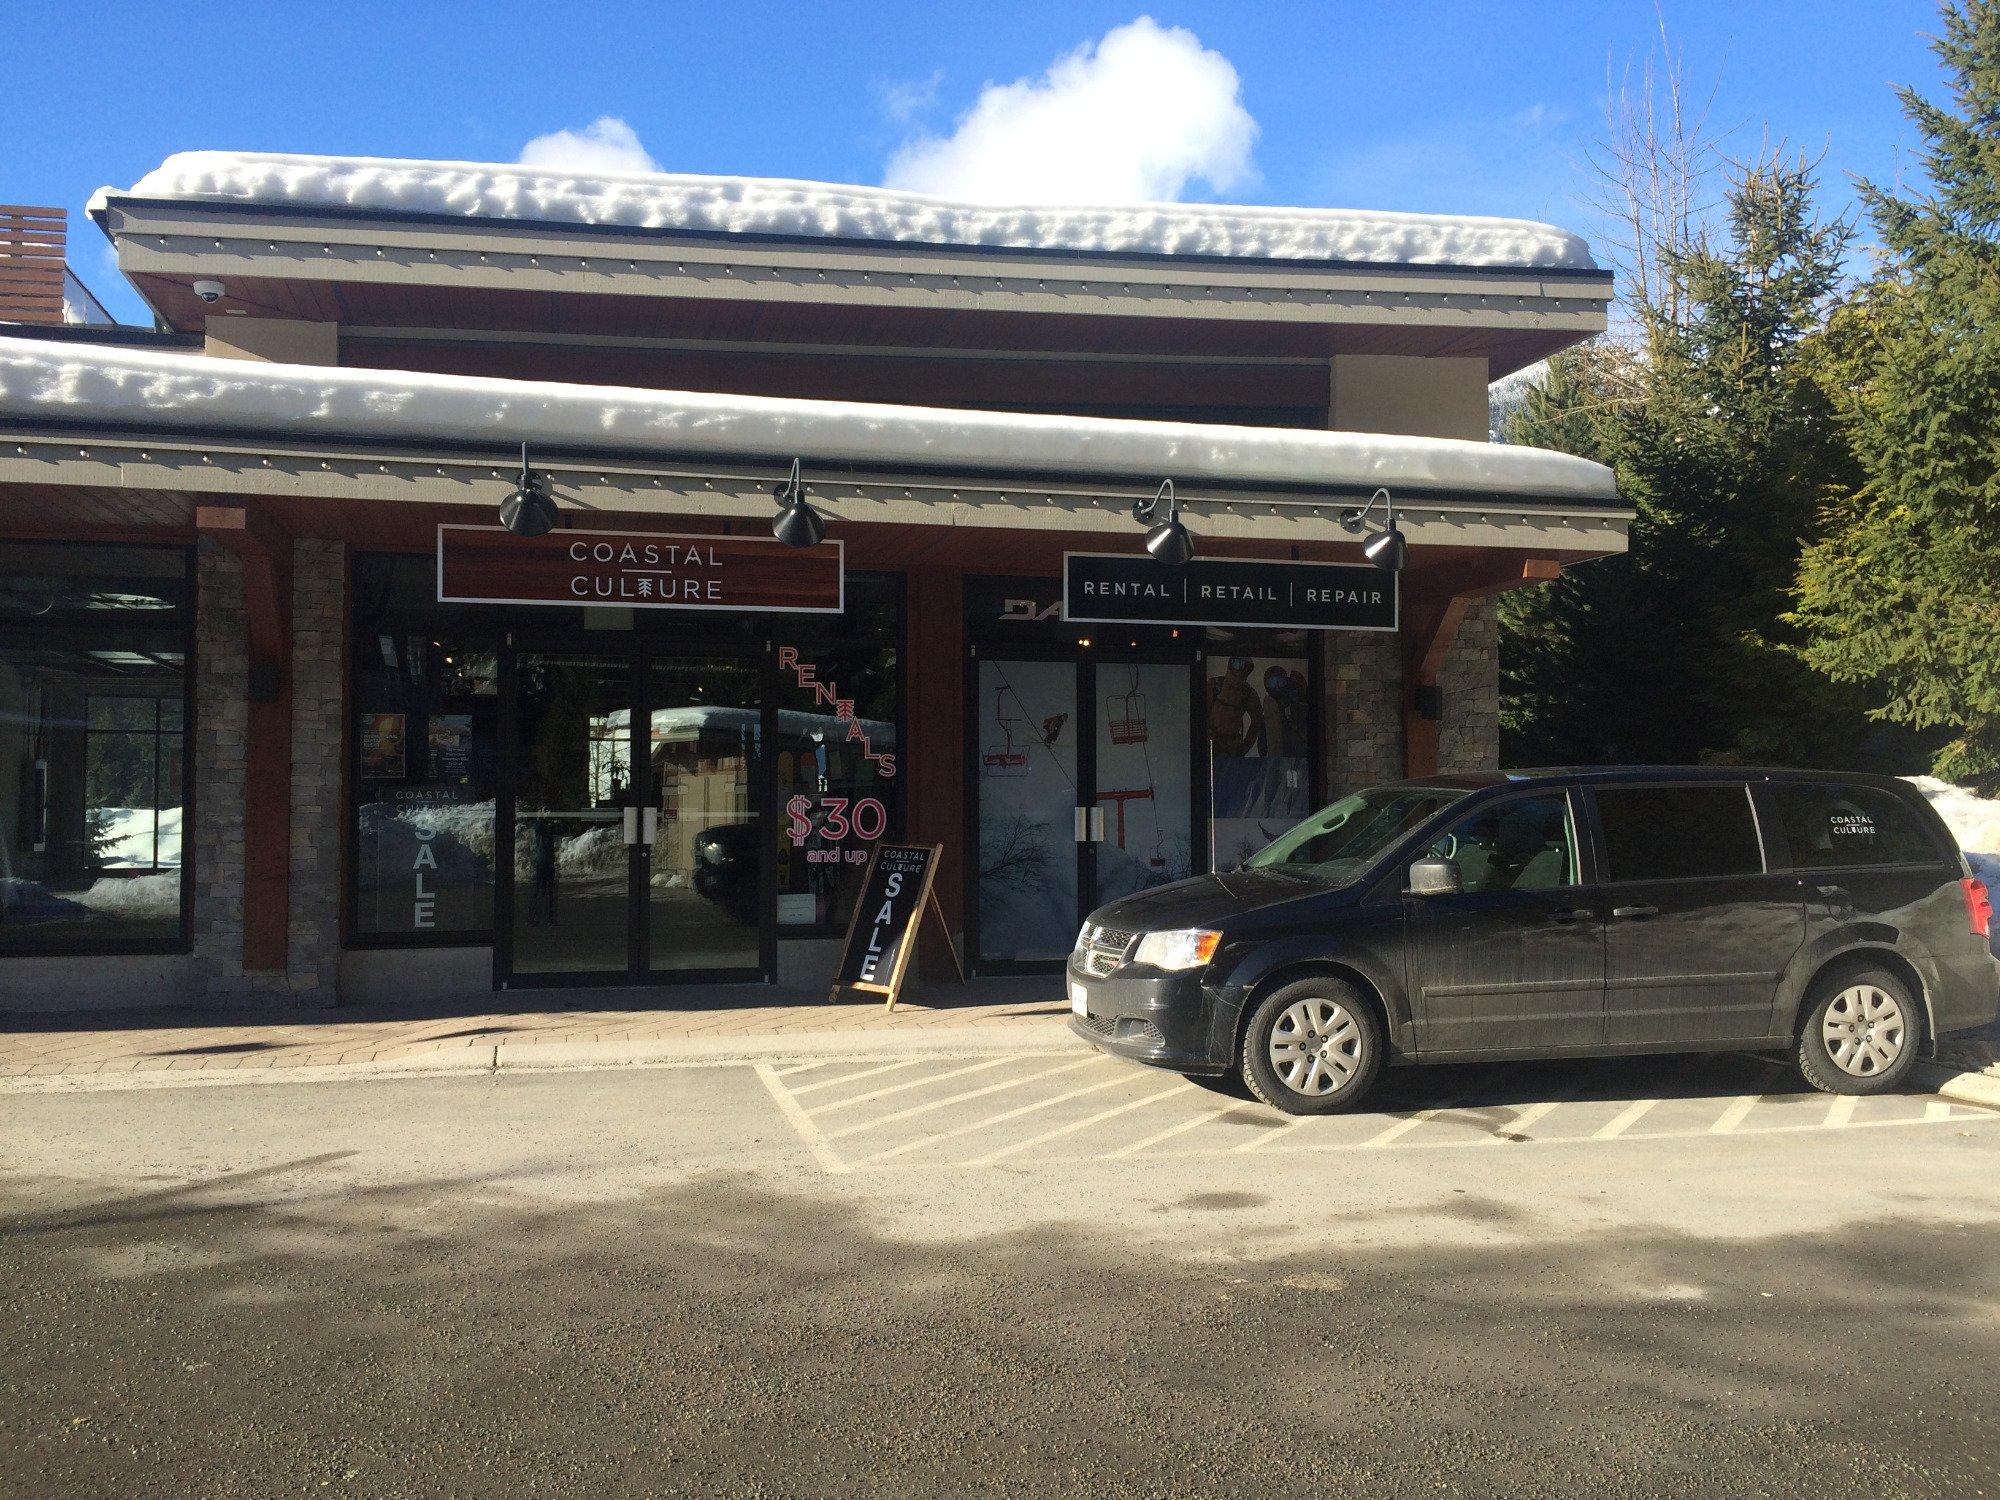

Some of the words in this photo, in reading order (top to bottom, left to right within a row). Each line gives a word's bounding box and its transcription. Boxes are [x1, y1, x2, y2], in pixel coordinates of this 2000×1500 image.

[569, 541, 723, 566] COASTAL
[570, 575, 722, 600] CULTURE
[1084, 581, 1170, 597] RENTAL
[1200, 585, 1277, 601] RETAIL
[1306, 589, 1382, 604] REPAIR
[779, 646, 897, 777] RENTALS
[395, 790, 459, 800] COASTAL
[786, 795, 887, 847] $30
[1830, 816, 1874, 824] COASTAL
[1833, 826, 1876, 834] CULTURE
[807, 847, 841, 863] and
[844, 850, 868, 865] up
[884, 850, 924, 861] COASTAL
[880, 861, 922, 873] CULTURE
[860, 872, 903, 982] SALE
